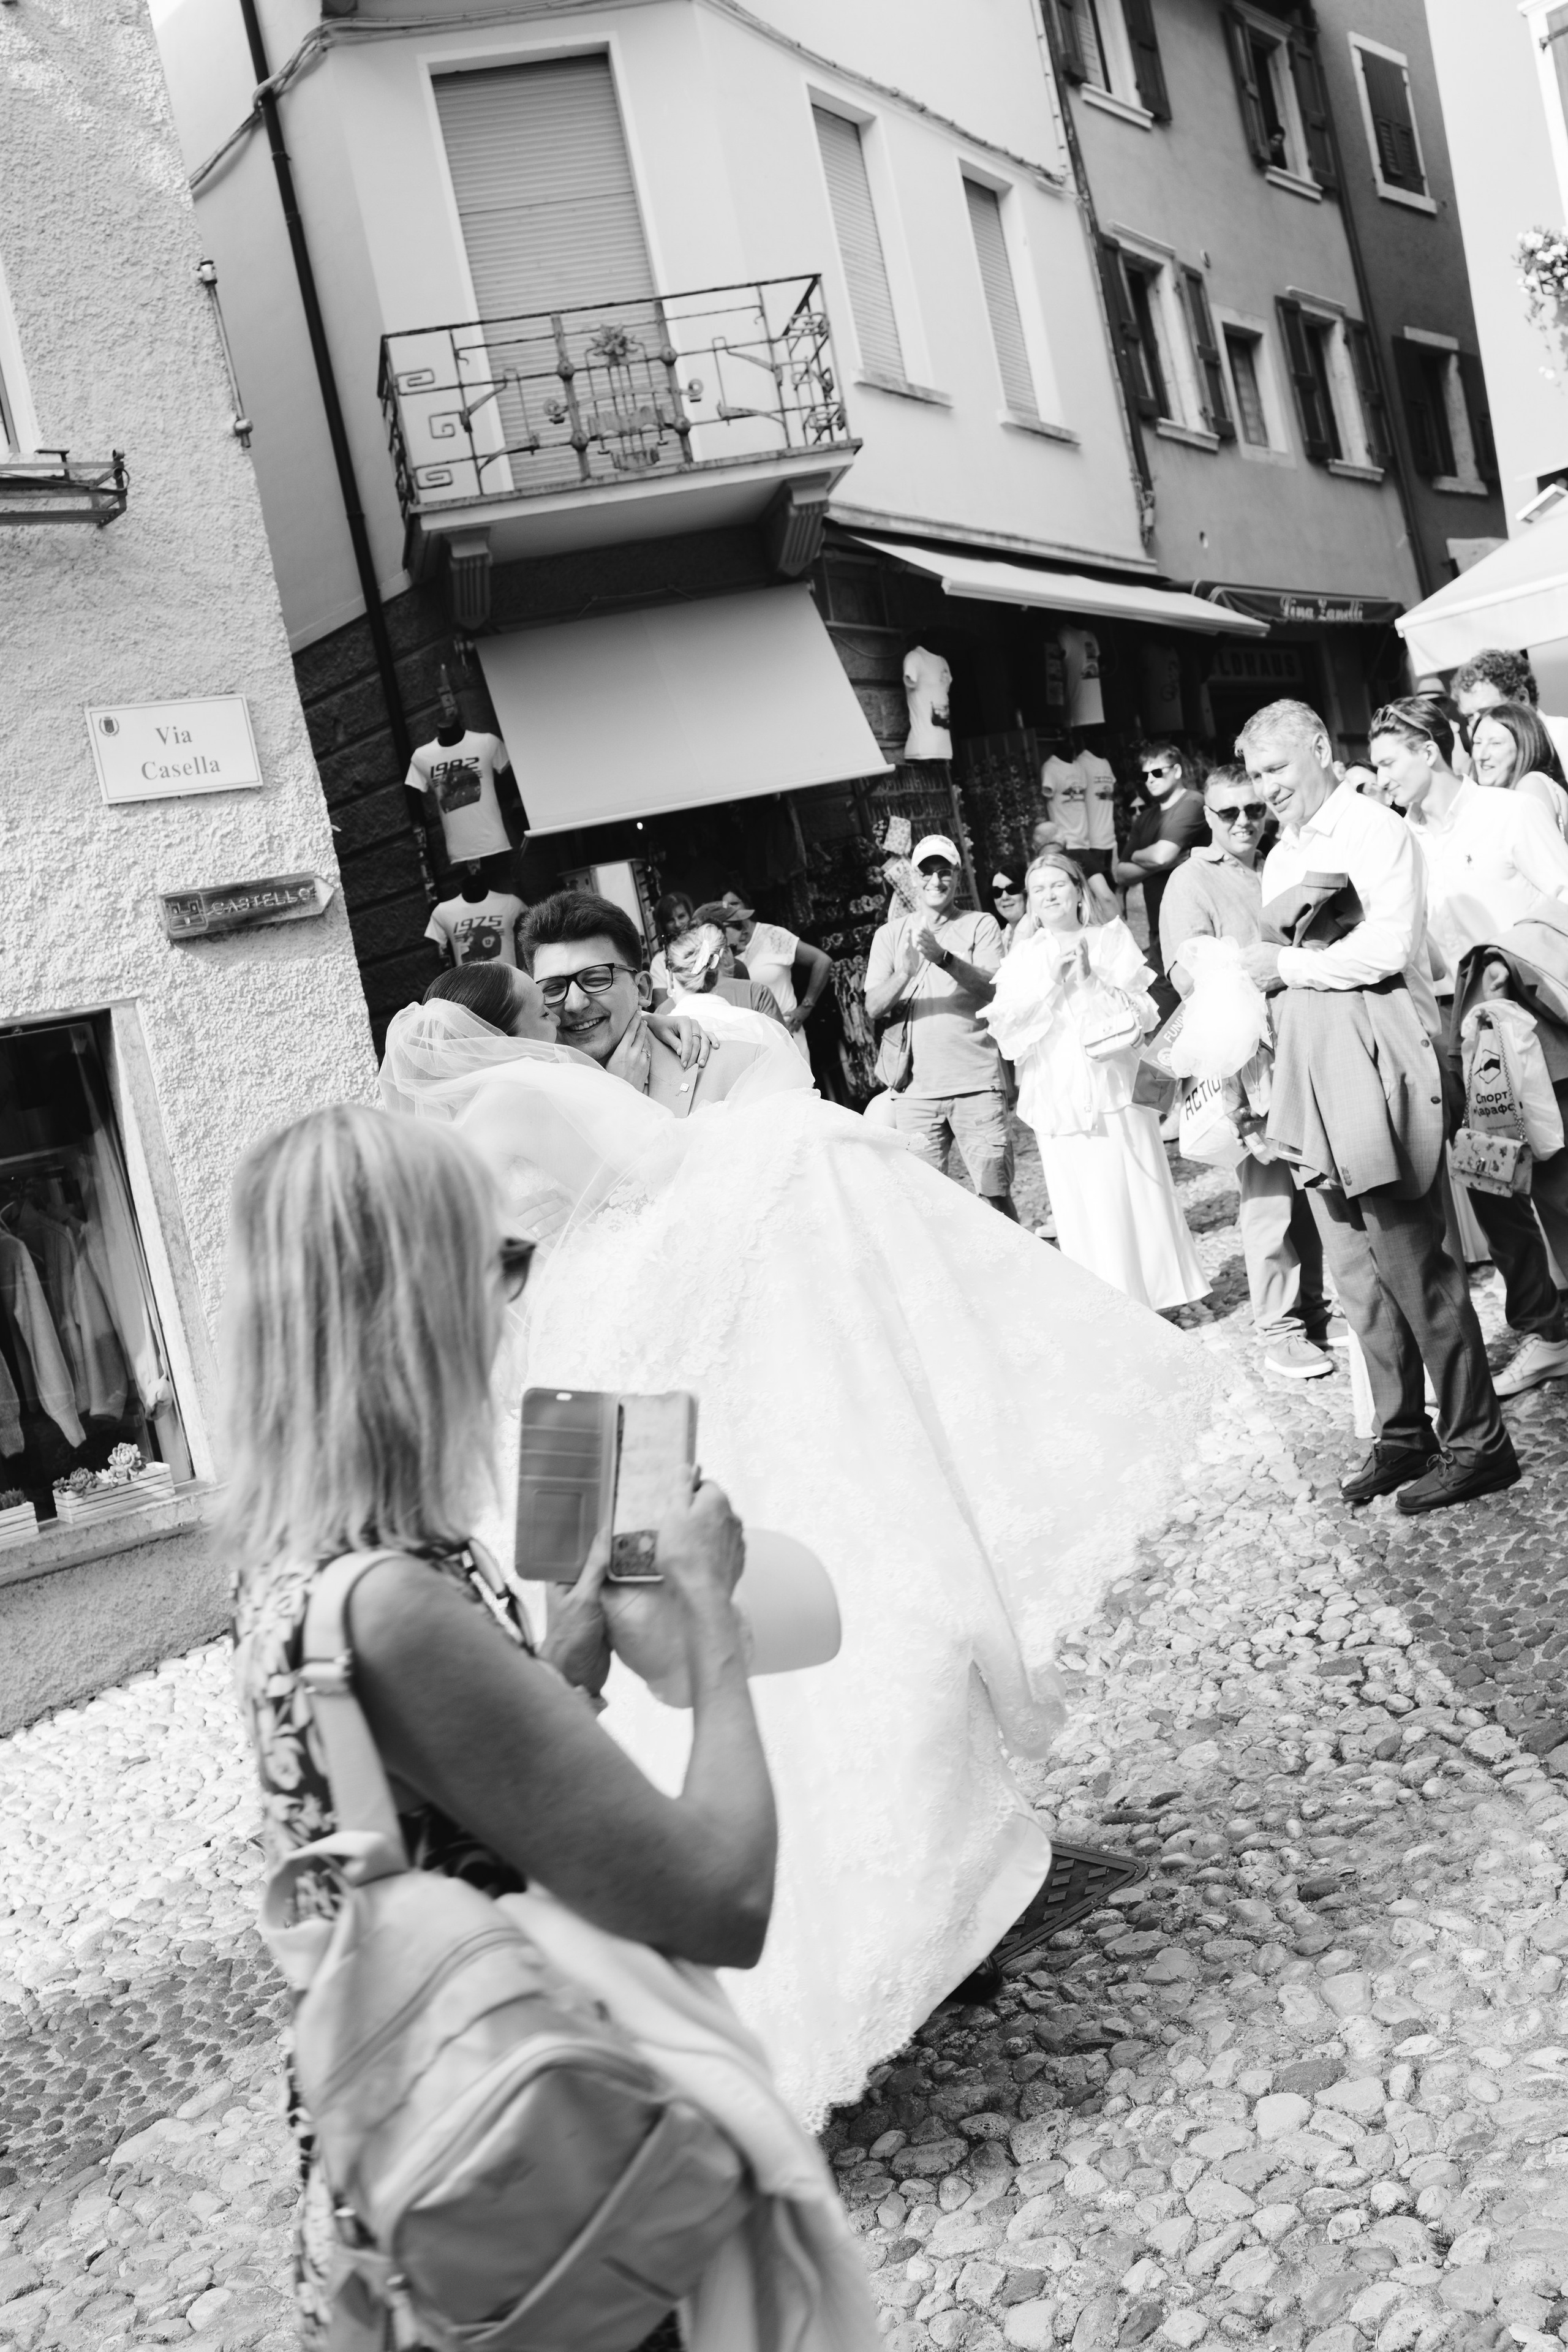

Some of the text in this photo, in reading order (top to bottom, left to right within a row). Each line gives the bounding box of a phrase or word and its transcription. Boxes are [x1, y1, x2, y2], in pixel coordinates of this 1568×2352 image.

[1212, 652, 1298, 677] LDHAUS
[155, 726, 192, 745] Via
[141, 756, 221, 780] Casella
[431, 757, 480, 779] 1982
[211, 888, 311, 916] CASTELLO
[454, 915, 503, 933] 1975
[1476, 1091, 1507, 1104] Спорт
[1473, 1101, 1523, 1117] арафо
